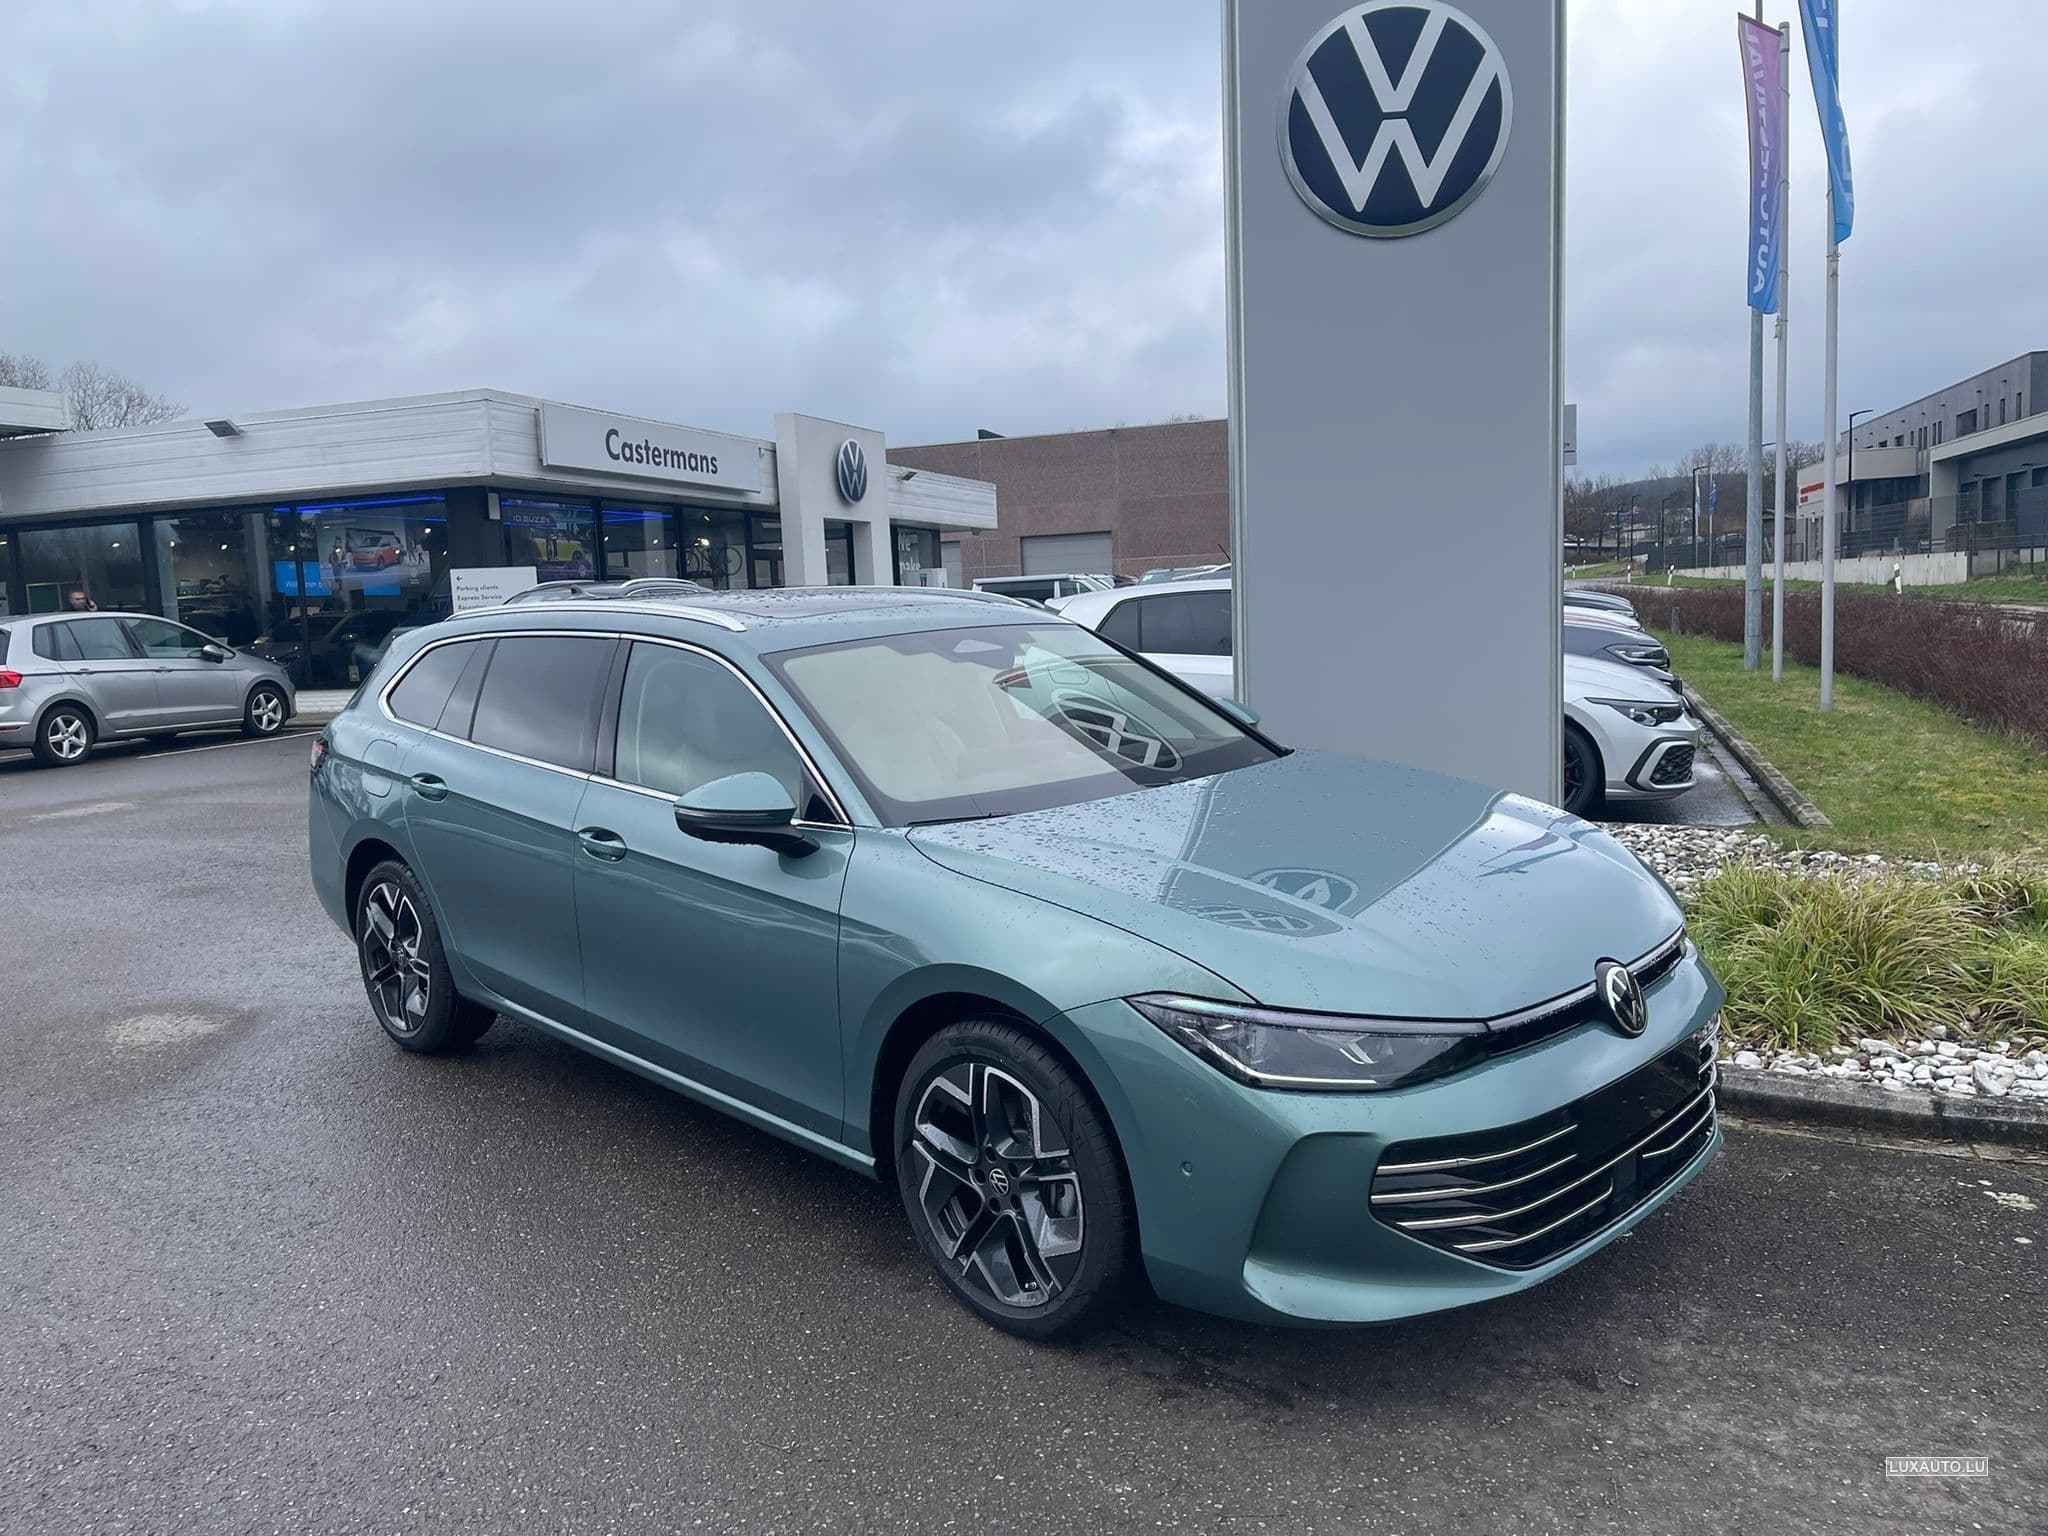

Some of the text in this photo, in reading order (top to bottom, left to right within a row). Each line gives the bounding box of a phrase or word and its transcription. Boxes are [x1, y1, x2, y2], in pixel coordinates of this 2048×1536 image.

[1287, 3, 1505, 213] VW
[605, 428, 718, 475] Castermans
[838, 440, 867, 499] VW
